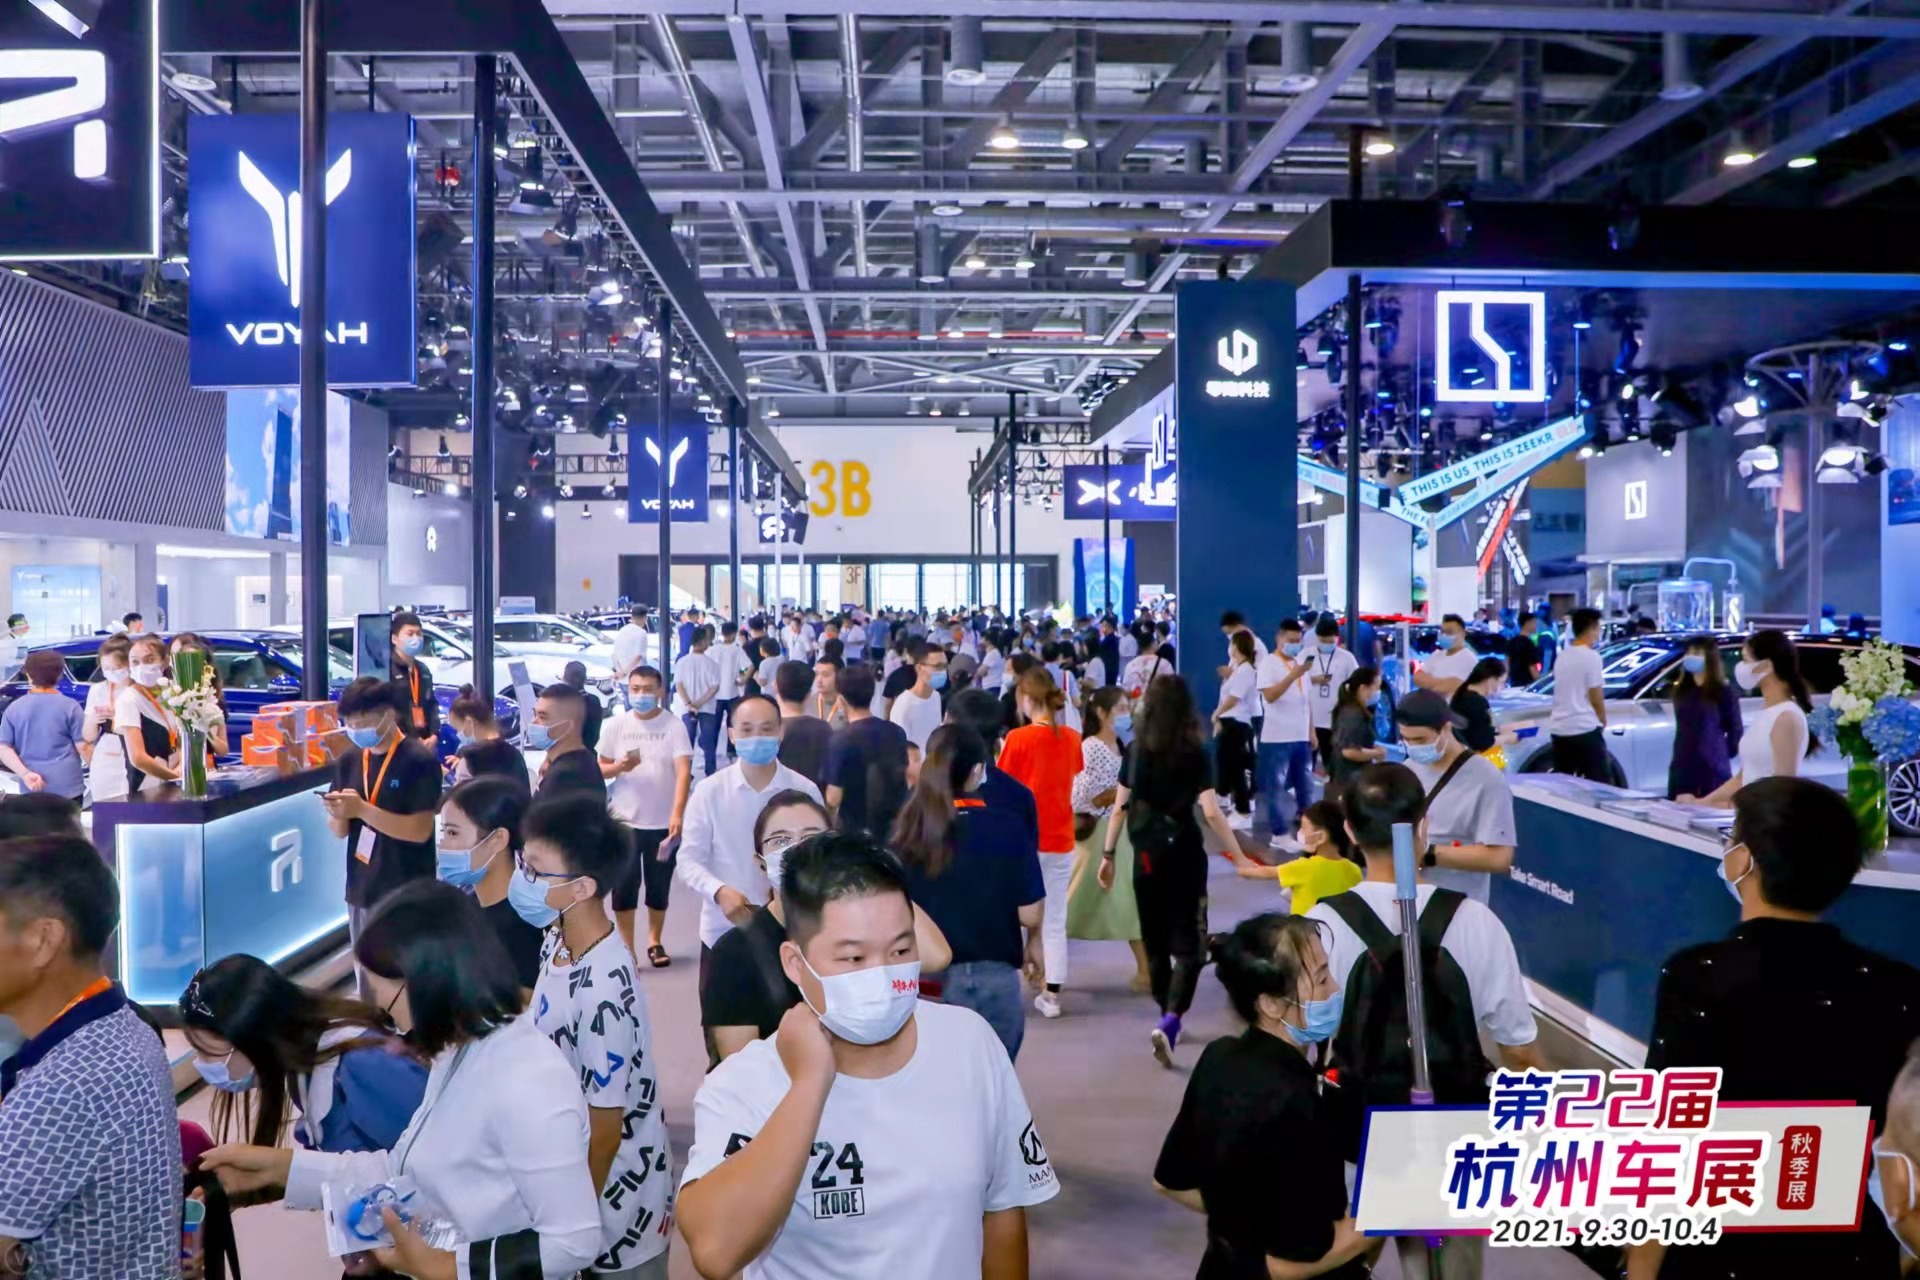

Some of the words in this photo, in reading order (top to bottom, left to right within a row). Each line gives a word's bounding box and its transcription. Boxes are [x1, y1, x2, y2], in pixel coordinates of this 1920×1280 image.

[810, 460, 872, 517] 3B
[1411, 478, 1439, 497] THIS
[1441, 473, 1452, 485] IS
[1454, 466, 1470, 479] US
[1474, 453, 1500, 471] THIS
[1503, 447, 1514, 459] IS
[1516, 432, 1553, 454] ZEEKR
[846, 566, 861, 584] 3F
[810, 1141, 864, 1189] 24
[821, 1191, 858, 1215] KOBE
